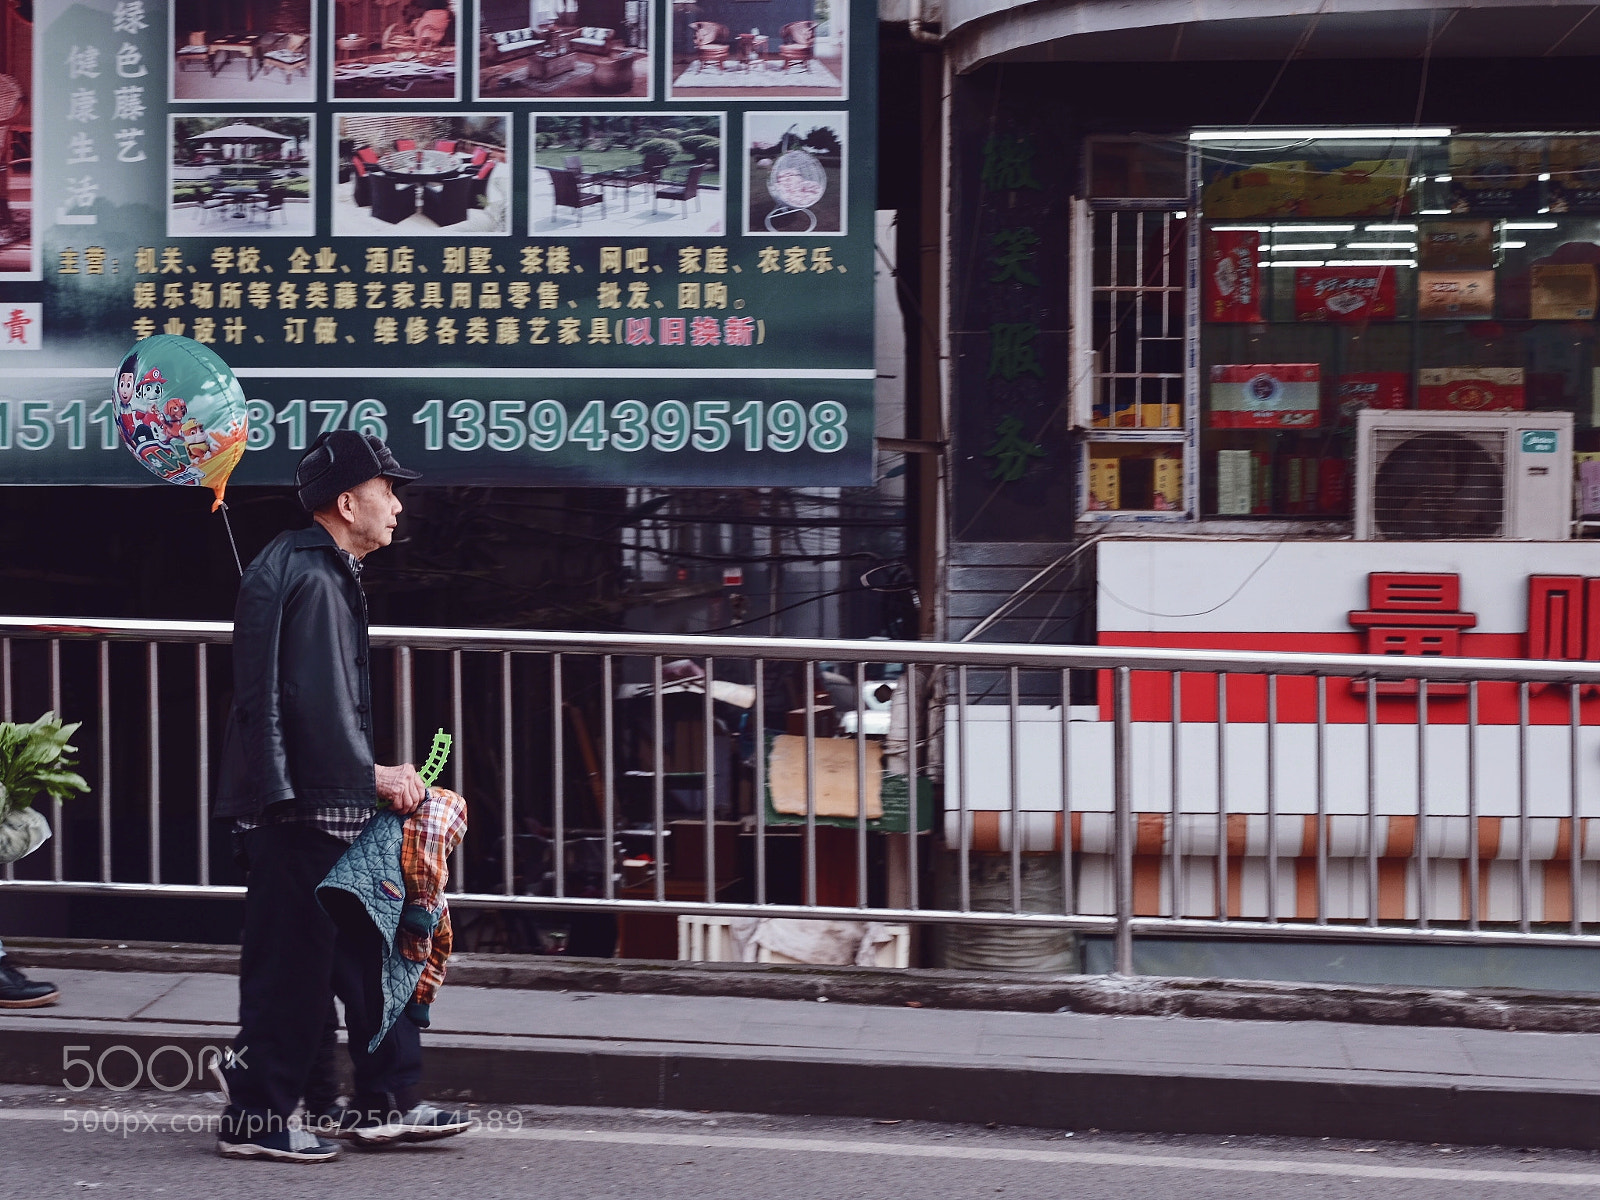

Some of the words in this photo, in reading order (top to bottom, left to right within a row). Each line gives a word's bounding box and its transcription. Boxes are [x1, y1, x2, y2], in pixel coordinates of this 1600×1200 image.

[64, 44, 102, 208] 健康生活
[111, 0, 149, 163] 绿色藤艺
[412, 399, 848, 453] 13594395198
